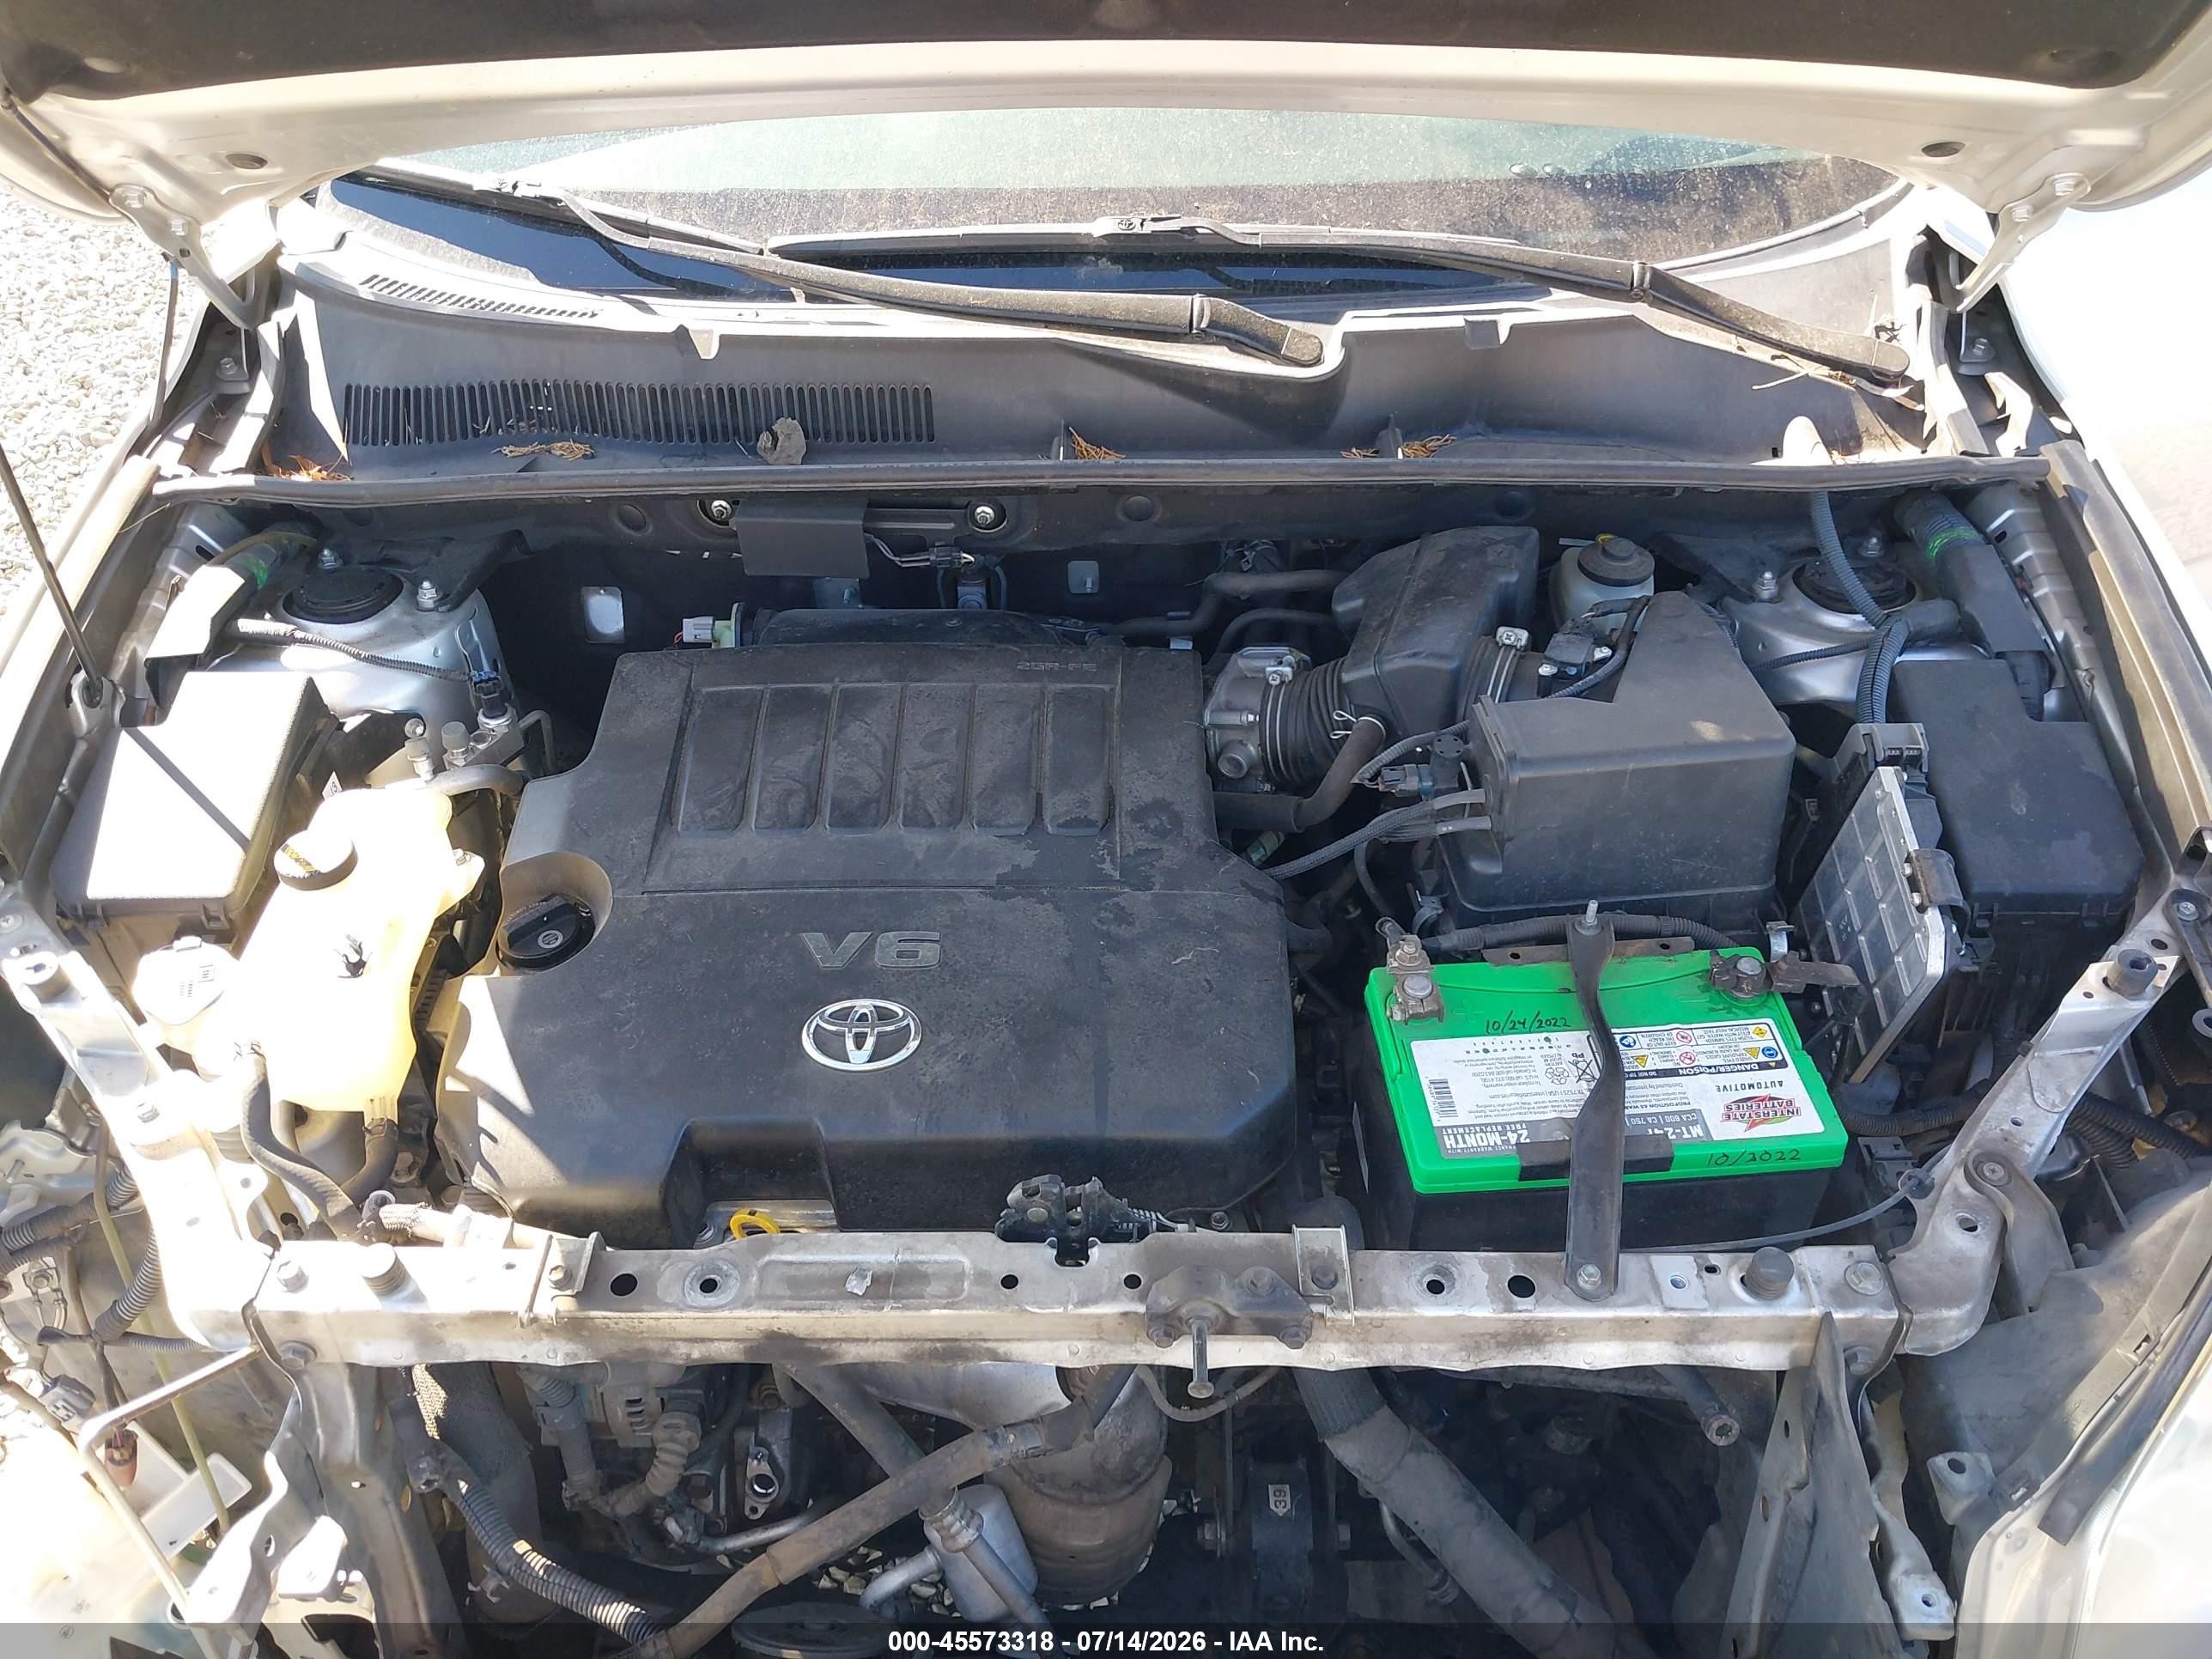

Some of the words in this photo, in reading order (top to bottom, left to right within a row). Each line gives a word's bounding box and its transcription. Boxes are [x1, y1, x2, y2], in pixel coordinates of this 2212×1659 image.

[799, 930, 942, 969] V6
[1486, 1010, 1571, 1035] 10/24/2022
[1678, 1062, 1759, 1075] DANGER/POISON
[1715, 1080, 1784, 1092] AUTOMOTIVE
[1725, 1100, 1793, 1112] BATTERIES
[1723, 1108, 1800, 1121] INTERSTATE
[1442, 1125, 1503, 1135] REPLACEMENT
[1504, 1122, 1527, 1131] FREE
[1443, 1129, 1531, 1150] 24-MONTH
[1707, 1148, 1802, 1168] 10/2022
